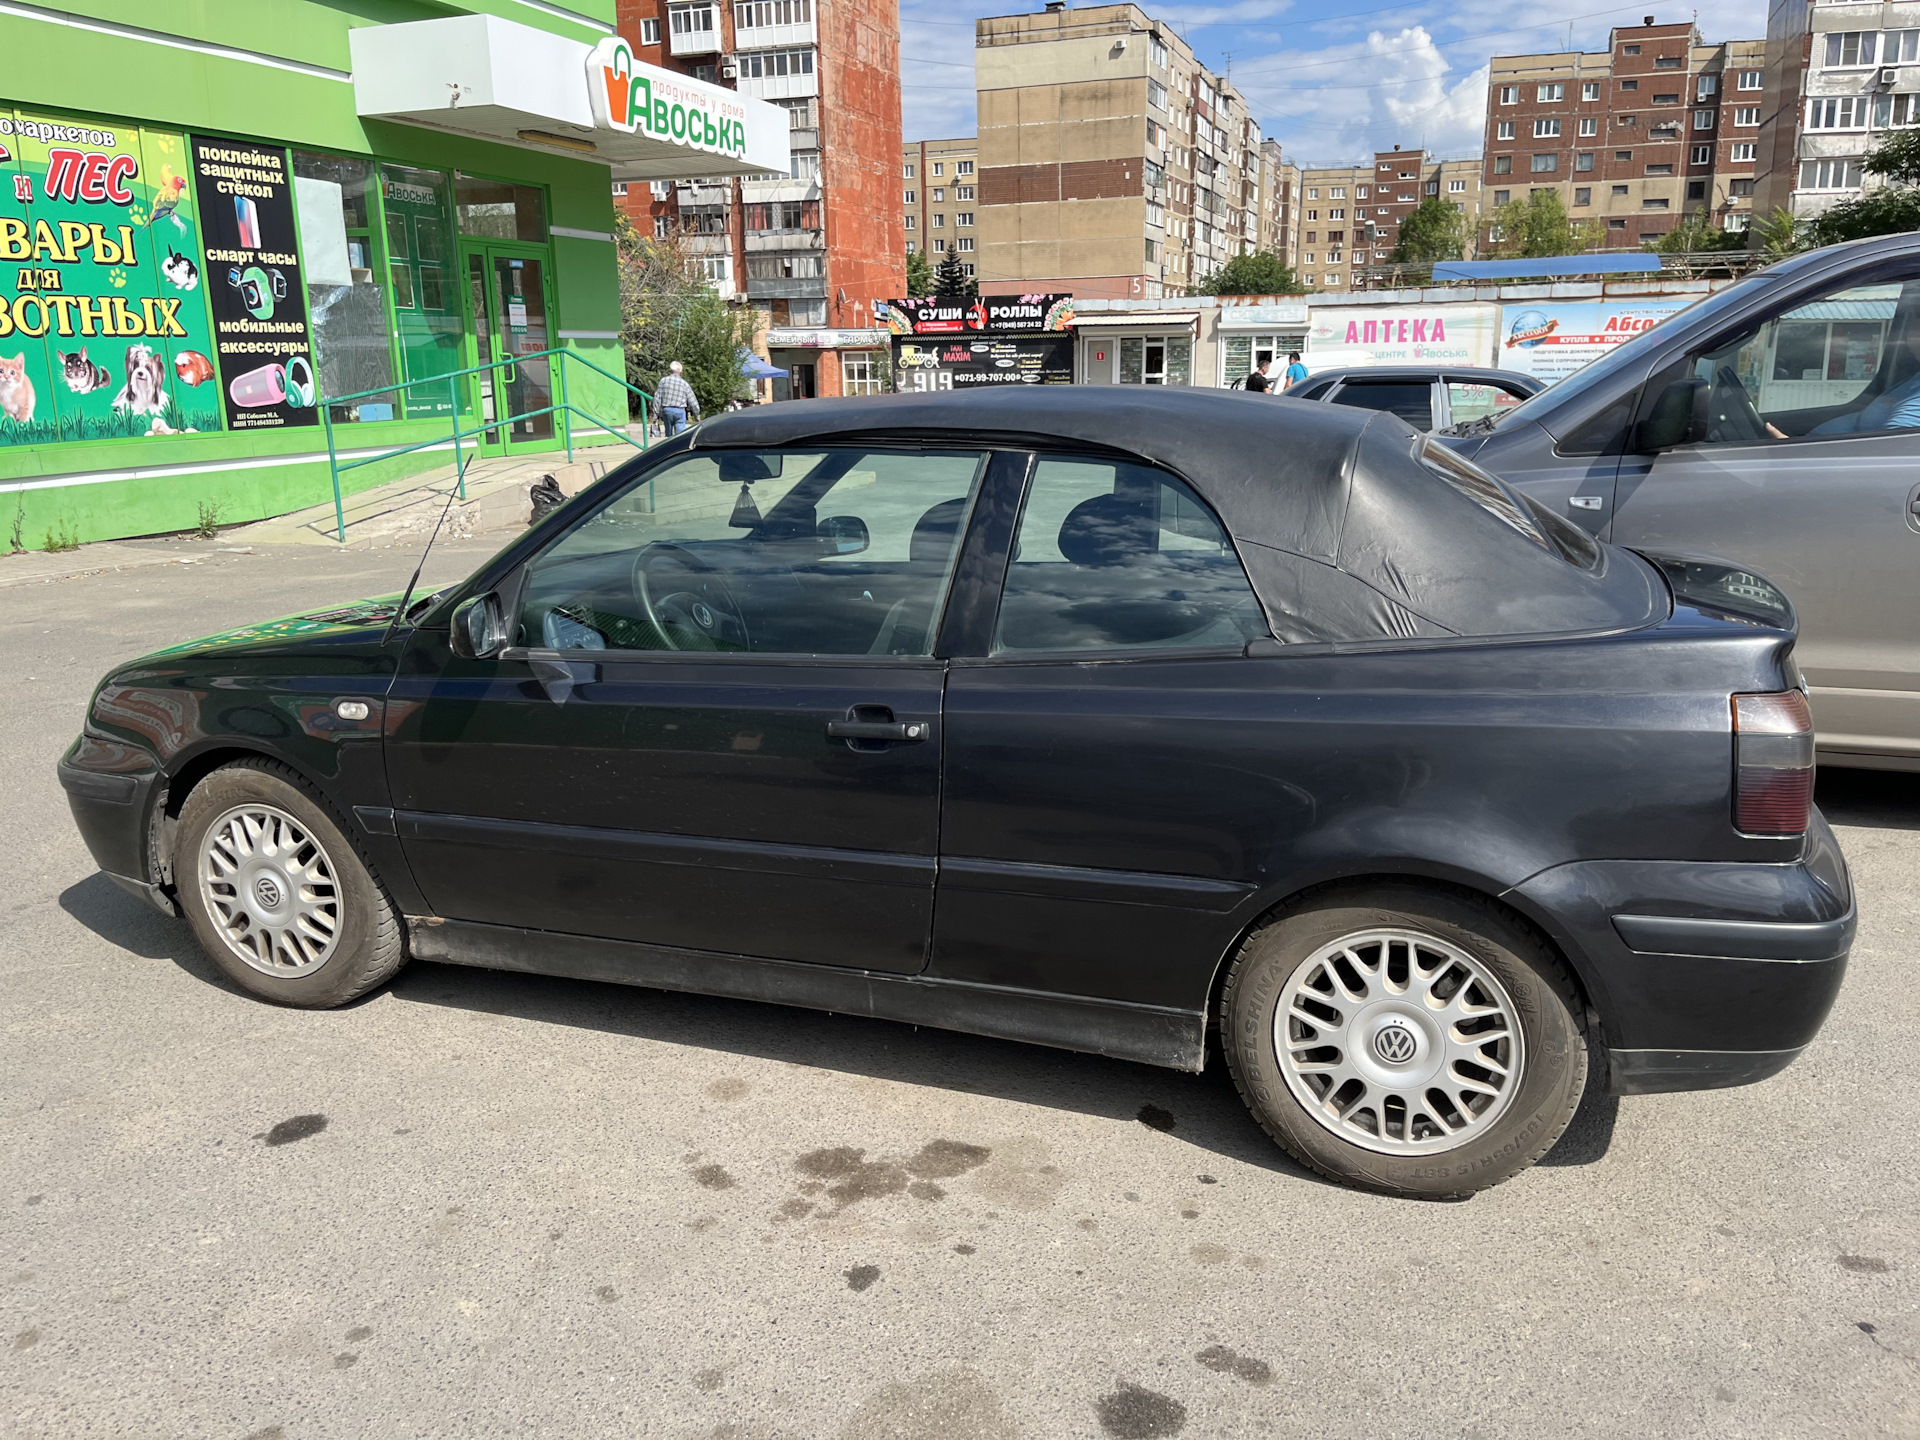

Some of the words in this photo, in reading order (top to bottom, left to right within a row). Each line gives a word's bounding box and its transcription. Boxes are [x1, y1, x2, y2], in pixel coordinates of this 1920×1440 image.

[199, 146, 281, 169] поклейка
[45, 147, 138, 206] ПЕС
[200, 163, 284, 184] защитных
[217, 179, 273, 198] стёкол
[206, 249, 254, 265] смарт
[258, 252, 297, 265] часы
[1133, 277, 1141, 293] 5
[918, 307, 963, 321] СУШИ
[990, 305, 1042, 319] РОЛЛЫ
[219, 318, 305, 333] мобильные
[1344, 318, 1446, 344] АПТЕКА
[768, 335, 816, 344] СЕМЕЙНЫЙ
[1560, 336, 1589, 344] КУПЛЯ
[220, 341, 309, 356] аксессуары
[1375, 351, 1407, 359] ЦЕНТРЕ
[943, 352, 971, 362] MAXIM
[959, 373, 1016, 382] 071-99-707-00
[1244, 961, 1284, 1081] BELSHINA
